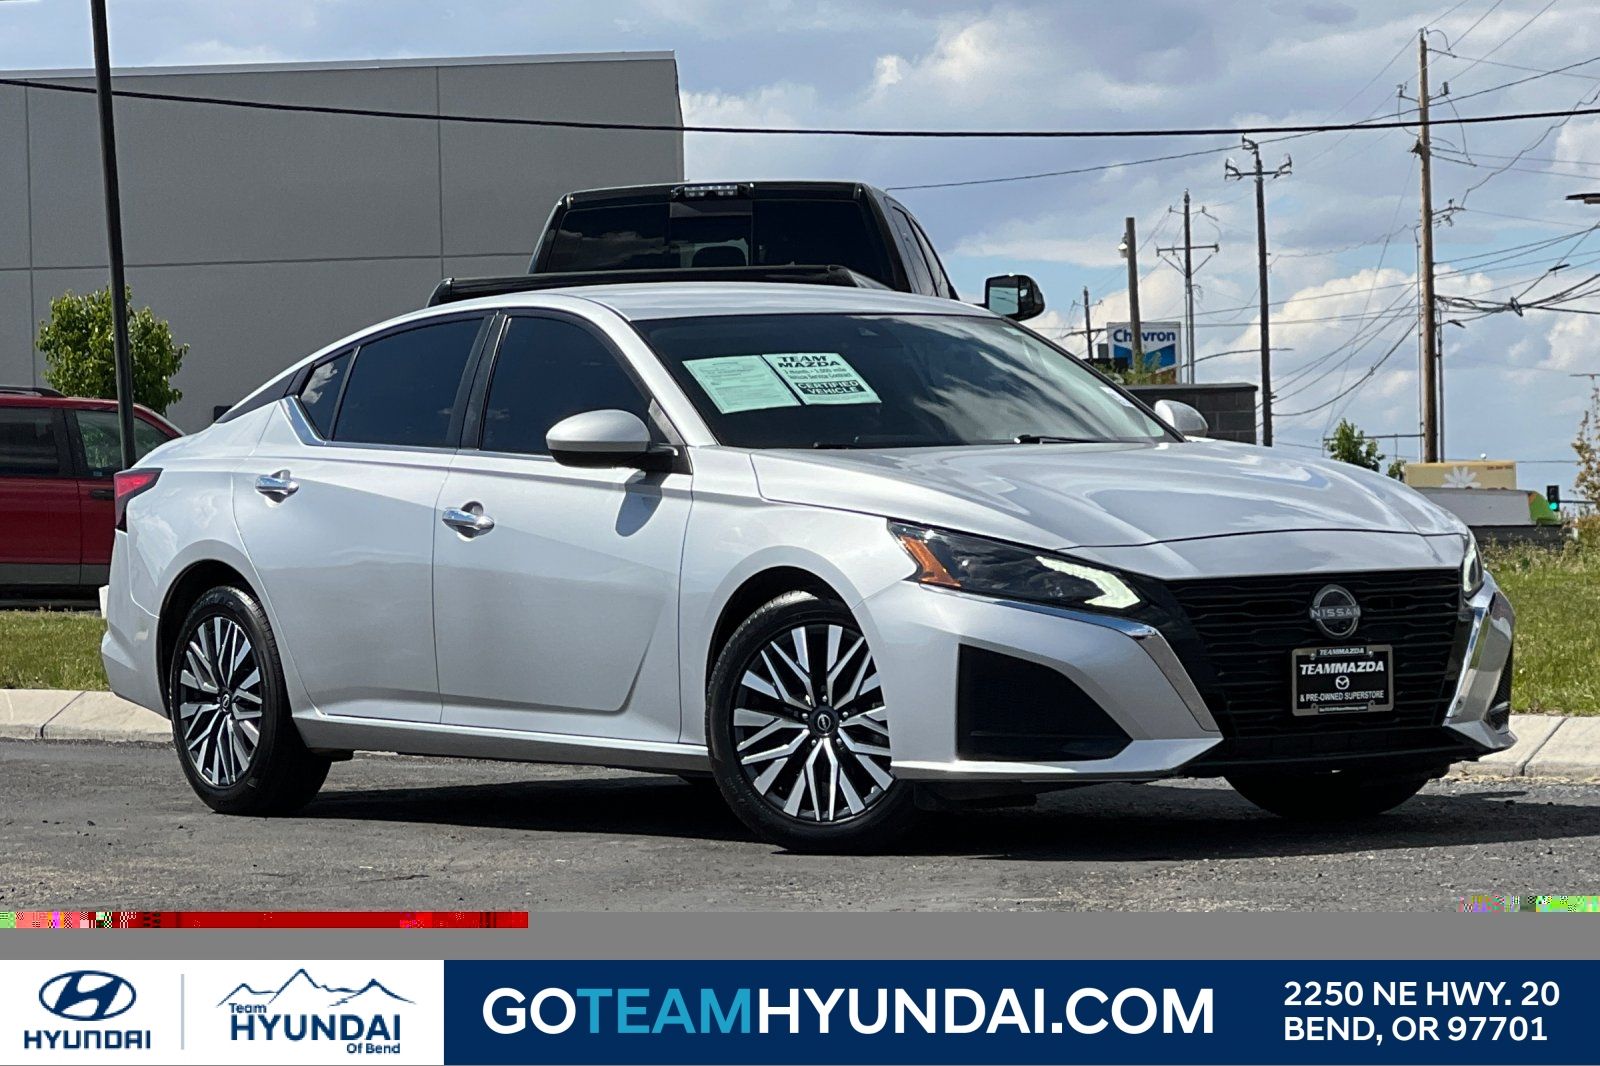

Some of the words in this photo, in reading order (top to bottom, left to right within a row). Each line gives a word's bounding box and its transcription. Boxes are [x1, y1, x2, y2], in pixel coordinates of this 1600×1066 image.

[1113, 329, 1176, 343] Chvron
[777, 355, 827, 363] TEAM
[797, 380, 859, 389] CERTIFIED
[807, 387, 859, 395] VEHICLE
[1310, 606, 1361, 618] NISSAN
[1300, 661, 1385, 675] TEAMMAZDA
[1300, 694, 1305, 702] &
[1305, 692, 1344, 702] PRE-OWNED
[1344, 690, 1384, 700] SUPERSTORE
